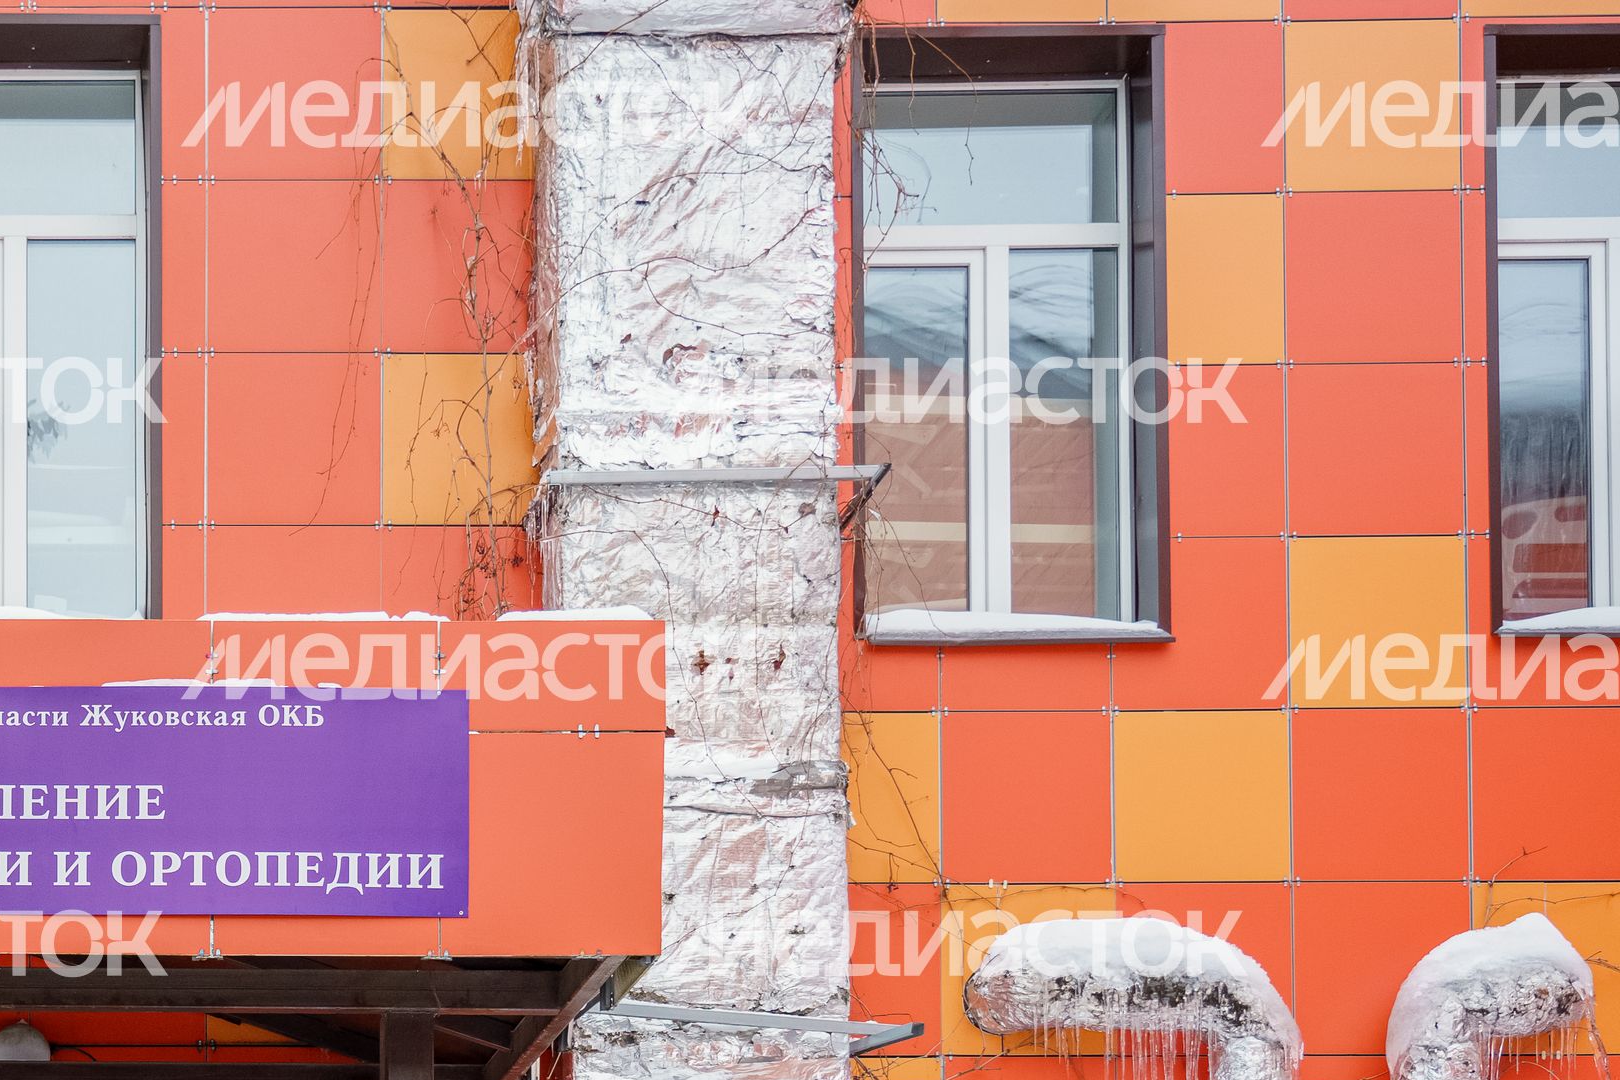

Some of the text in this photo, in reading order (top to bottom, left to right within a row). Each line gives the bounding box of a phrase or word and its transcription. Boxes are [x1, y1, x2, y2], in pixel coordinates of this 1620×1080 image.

[80, 704, 246, 733] Жуковская
[258, 705, 325, 728] ОКБ
[53, 851, 91, 886] И
[111, 851, 444, 895] ОРТОПЕДИИ
